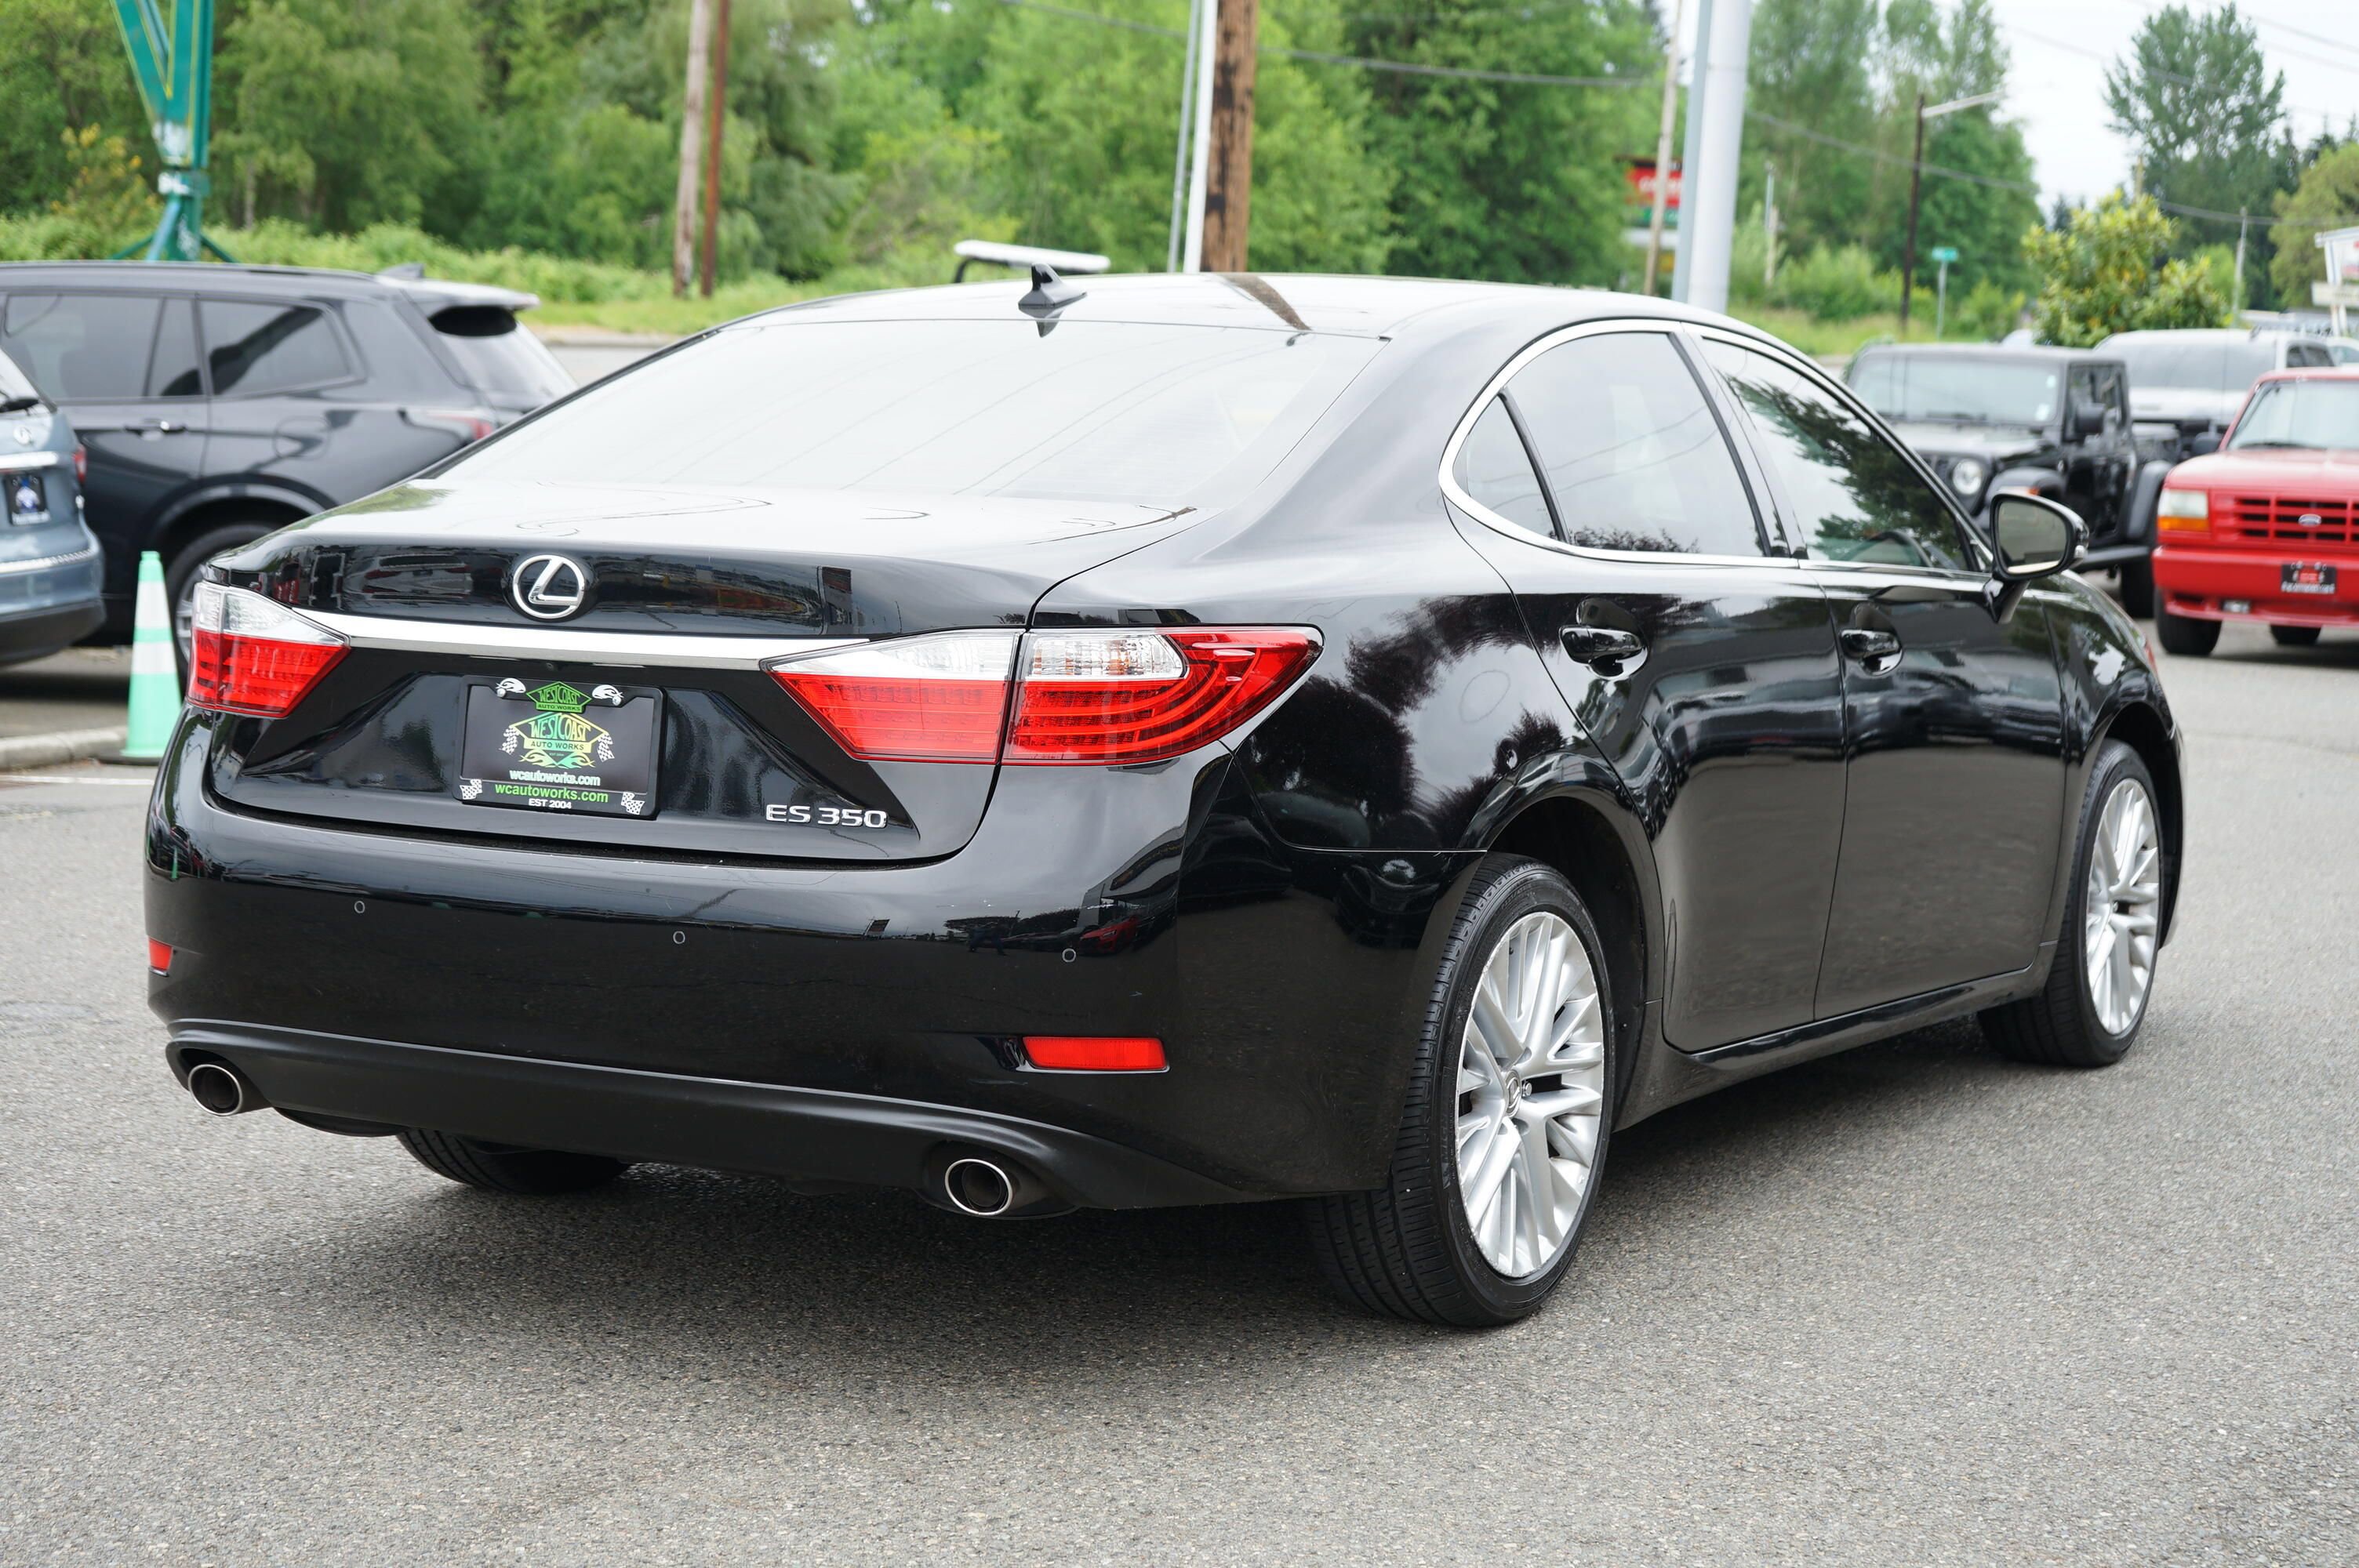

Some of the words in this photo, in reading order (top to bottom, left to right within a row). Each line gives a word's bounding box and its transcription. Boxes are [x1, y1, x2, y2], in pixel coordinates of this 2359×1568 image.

[554, 742, 584, 751] WORKS
[509, 770, 602, 786] wcautoworks.com
[495, 784, 609, 803] wcautoworks.com
[528, 798, 548, 808] EST
[548, 800, 572, 809] 2004
[765, 804, 811, 823] ES
[817, 808, 888, 829] 350
